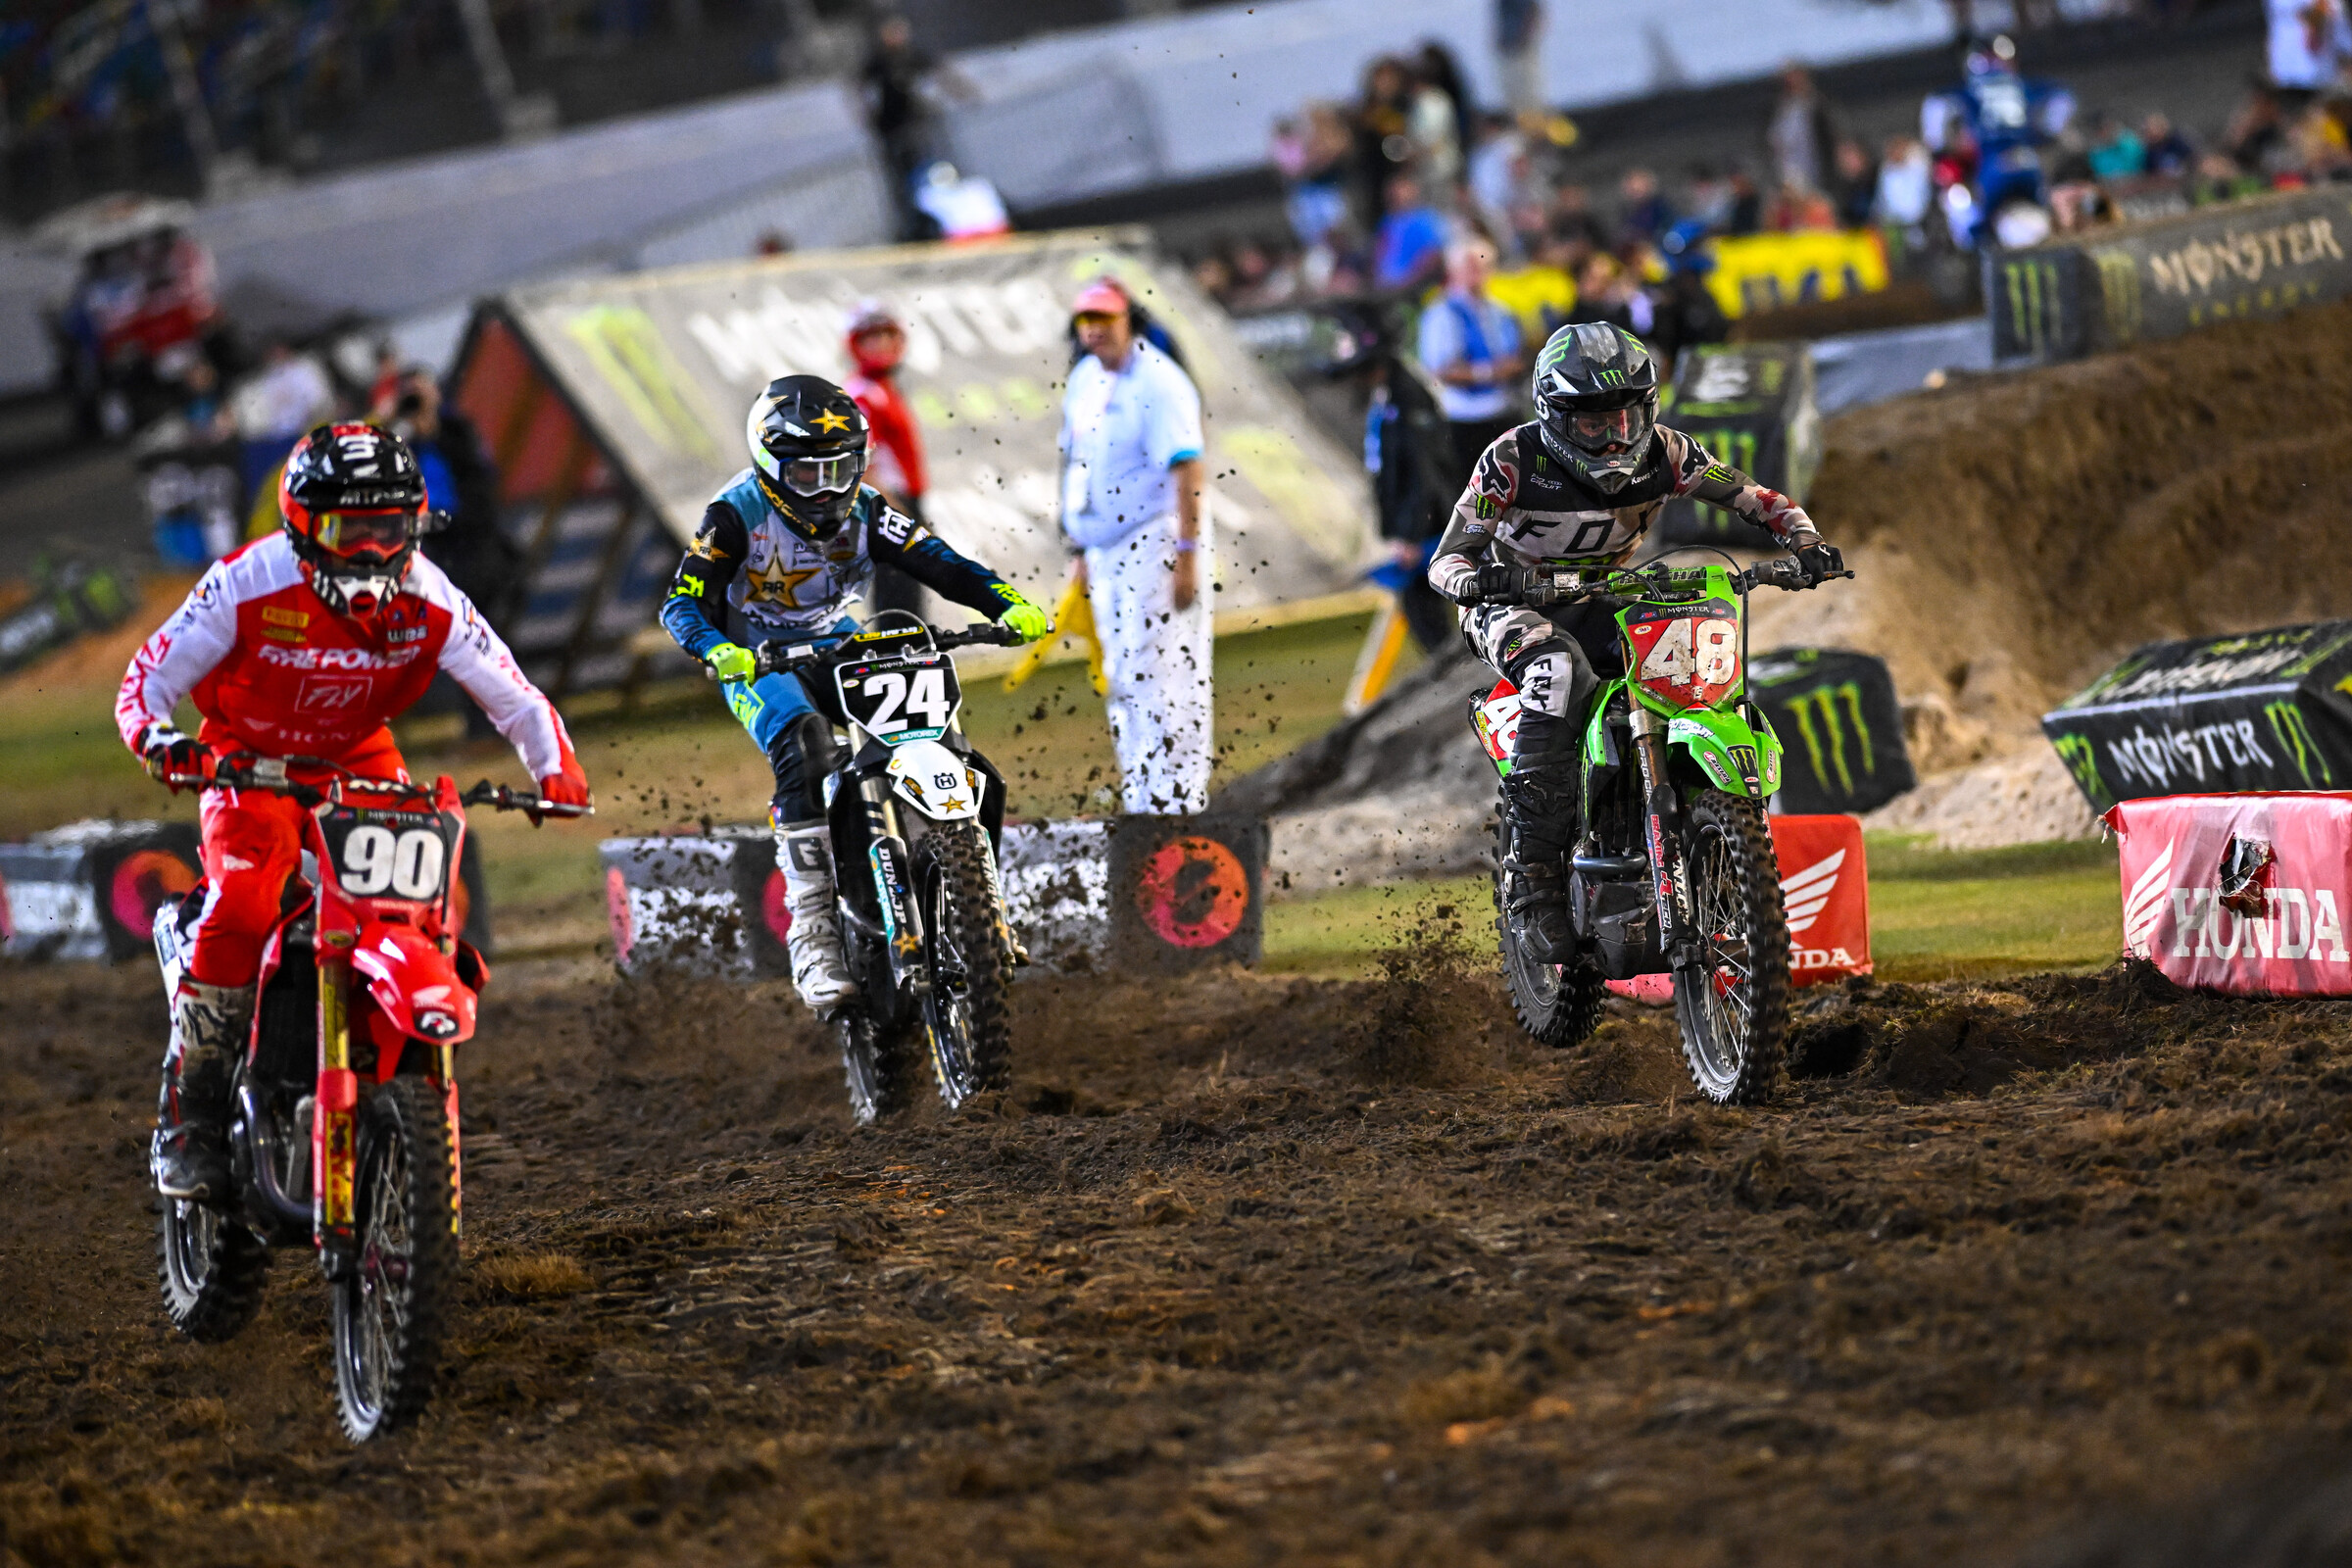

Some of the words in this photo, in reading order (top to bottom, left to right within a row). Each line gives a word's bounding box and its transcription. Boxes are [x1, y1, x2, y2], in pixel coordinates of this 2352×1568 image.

[2149, 217, 2344, 296] MONSTER
[1510, 502, 1664, 554] FOX
[1619, 568, 1706, 585] RNHA
[1640, 617, 1739, 687] 48
[304, 683, 364, 709] FLY
[863, 668, 951, 737] 24
[899, 728, 939, 740] MOTOREX
[2108, 718, 2275, 790] MONSTER
[341, 825, 444, 900] 90
[1650, 814, 1664, 867] BRAKING
[2171, 887, 2350, 962] HONDA
